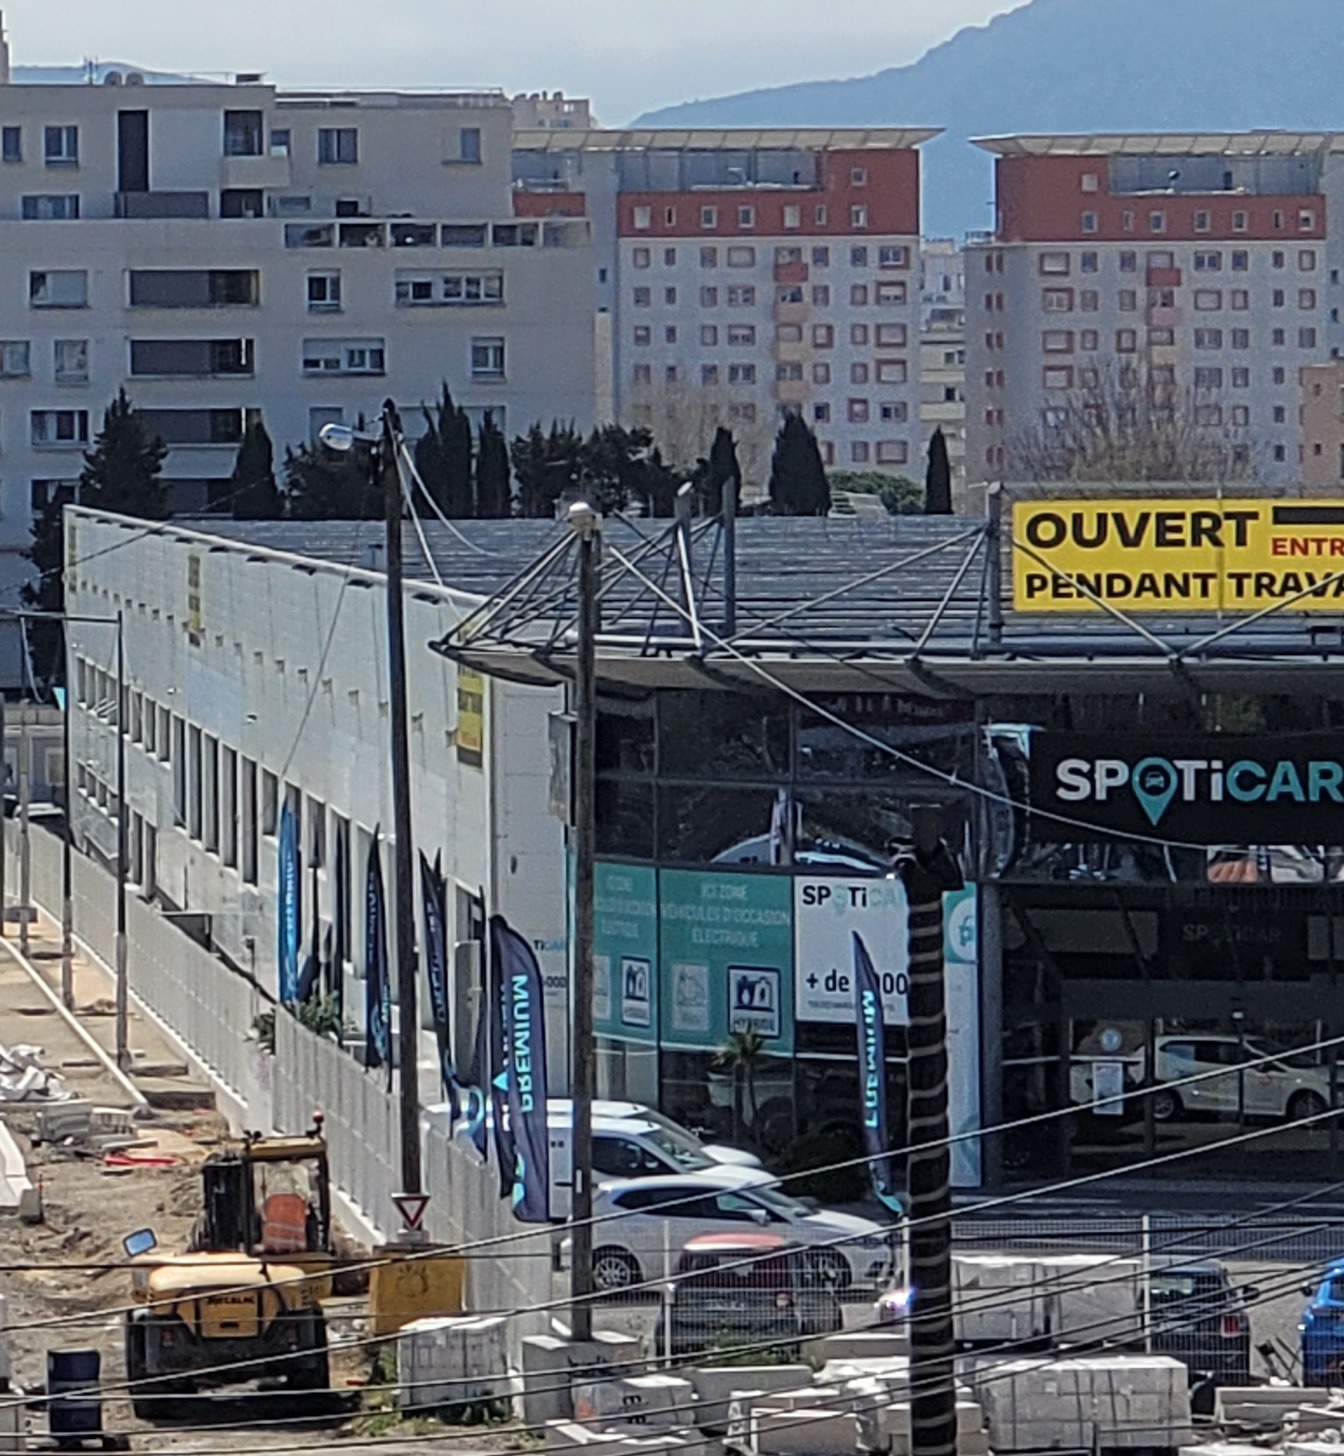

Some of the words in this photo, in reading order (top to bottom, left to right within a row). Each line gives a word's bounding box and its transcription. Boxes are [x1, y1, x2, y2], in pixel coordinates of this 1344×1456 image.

[1025, 511, 1259, 548] OUVERT
[1025, 572, 1217, 599] PENDANT
[825, 968, 850, 992] de
